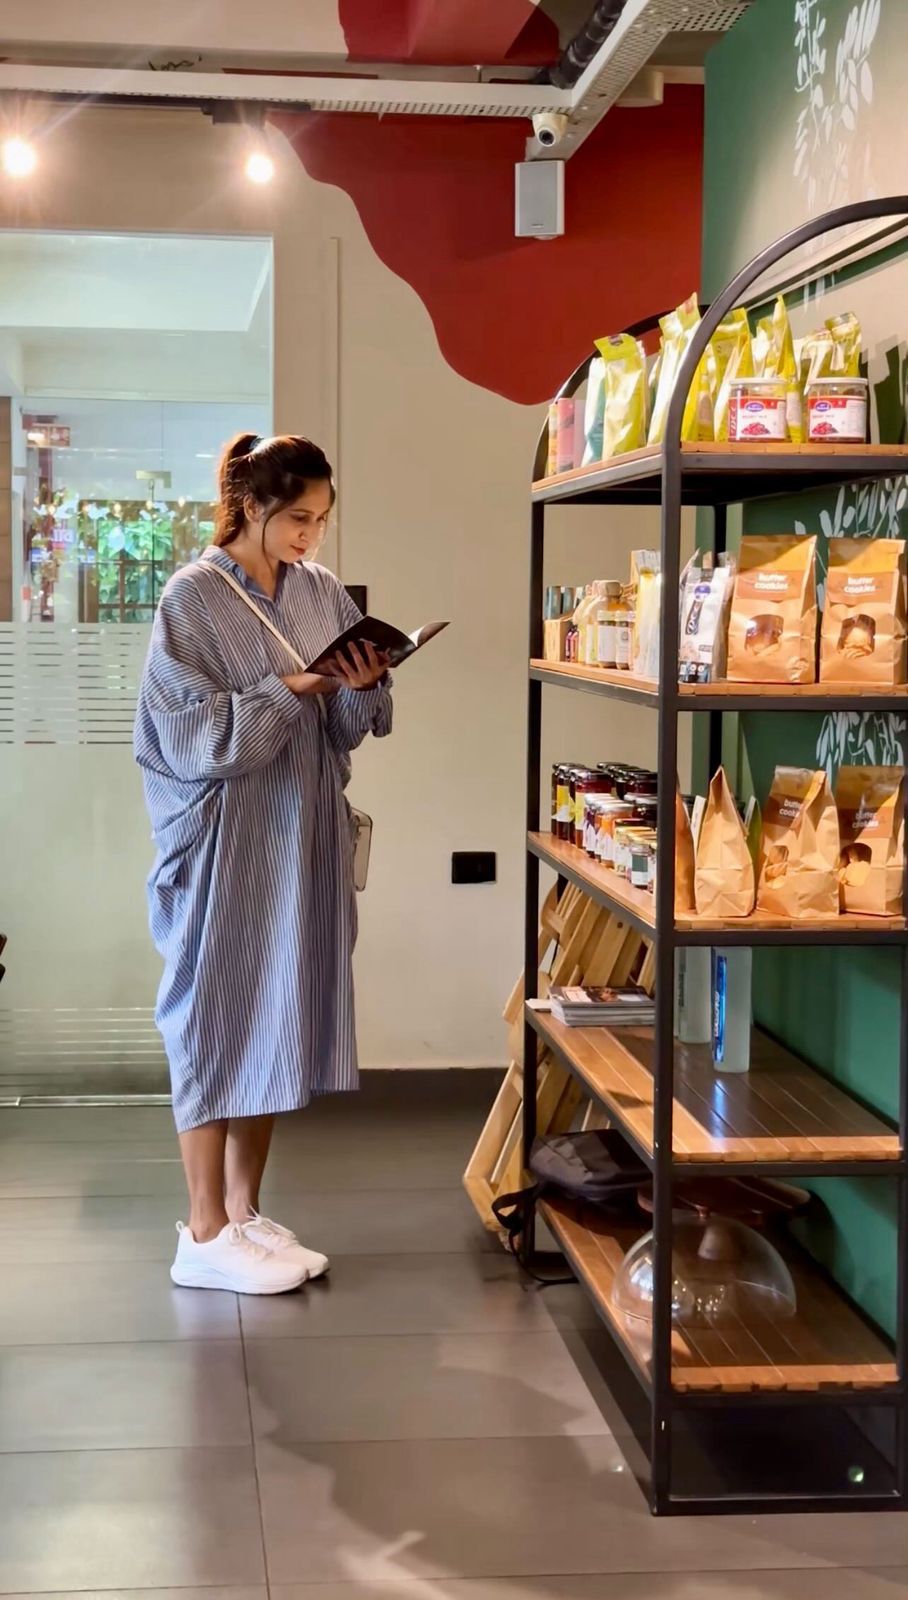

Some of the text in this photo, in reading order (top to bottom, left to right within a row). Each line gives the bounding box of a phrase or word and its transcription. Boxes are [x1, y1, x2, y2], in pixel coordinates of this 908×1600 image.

[758, 572, 786, 581] butter
[848, 576, 874, 585] butter
[754, 581, 788, 591] cookies
[844, 585, 876, 593] cookies
